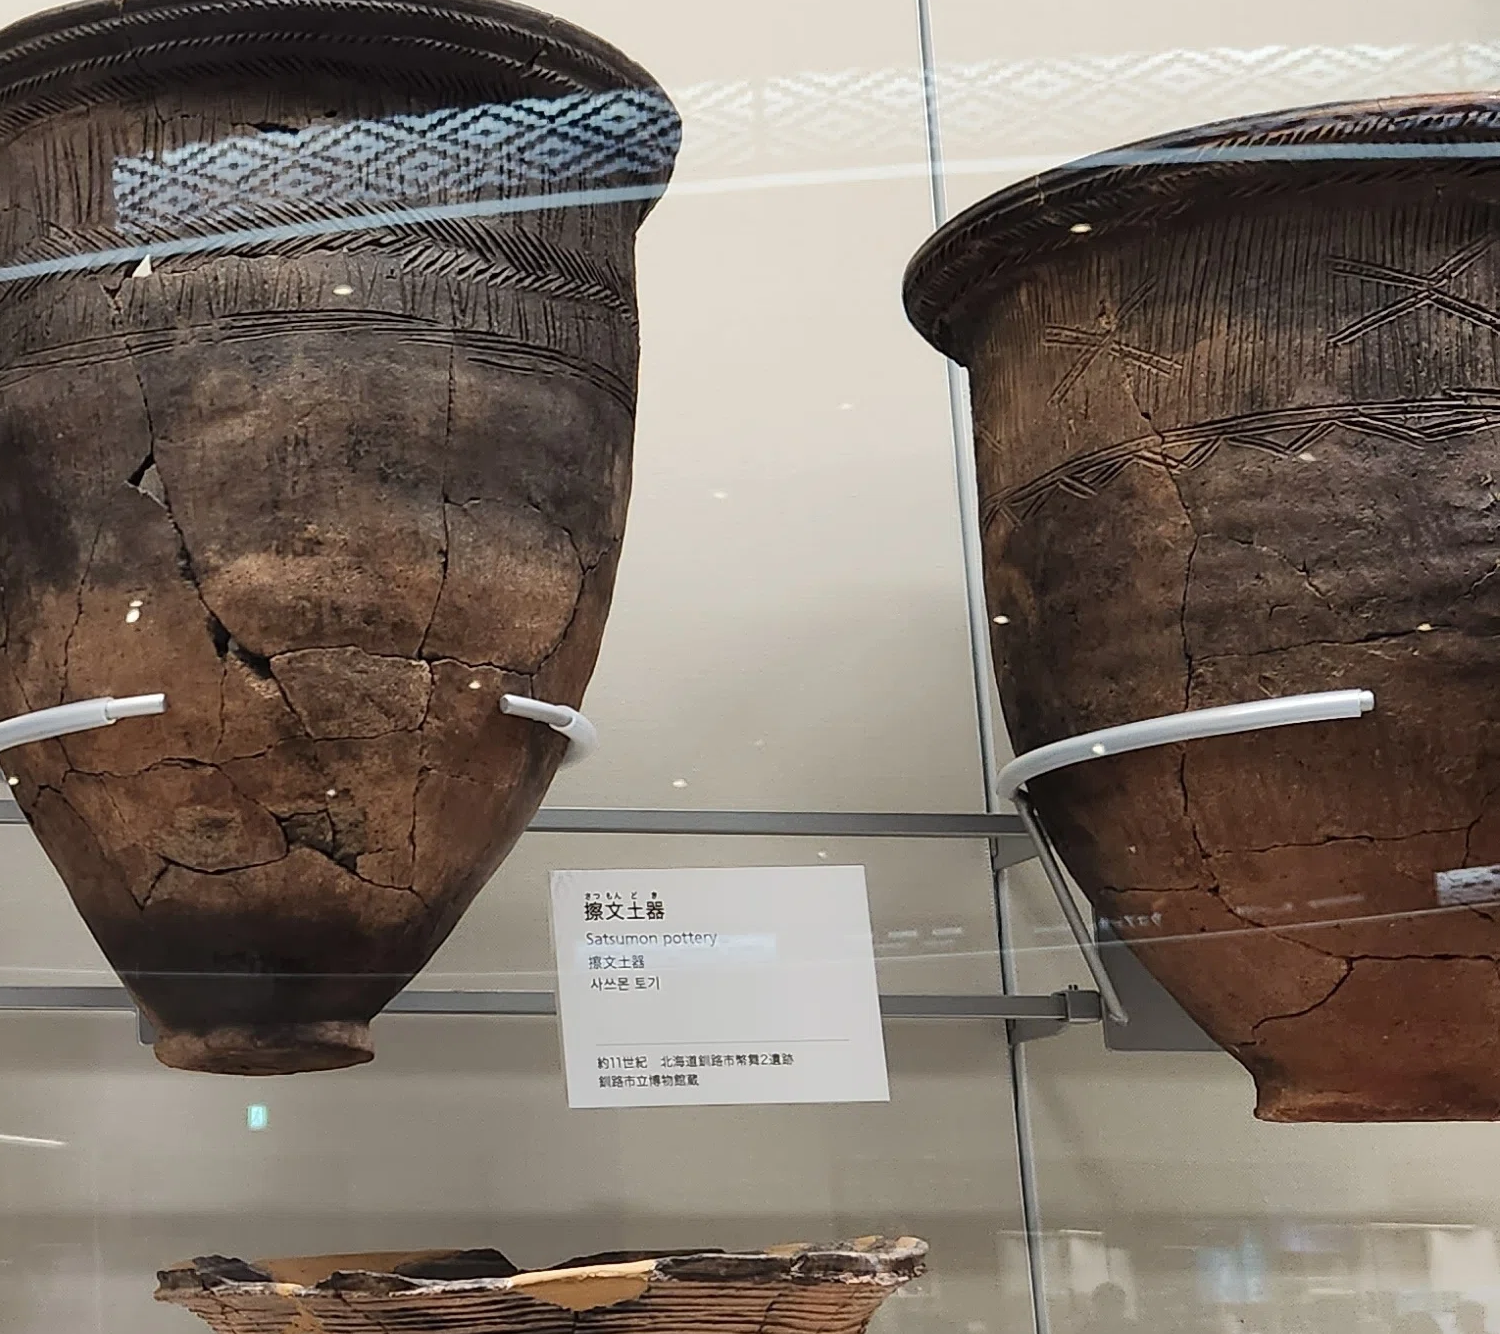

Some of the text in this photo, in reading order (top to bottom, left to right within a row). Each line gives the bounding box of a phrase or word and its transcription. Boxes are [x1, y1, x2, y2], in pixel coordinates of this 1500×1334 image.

[584, 901, 665, 921] 擦文土器
[586, 932, 717, 947] Satsumon pottery
[588, 954, 645, 970] 擦文土器
[591, 976, 660, 991] 사쓰몬 토기
[597, 1055, 648, 1069] 約11世紀
